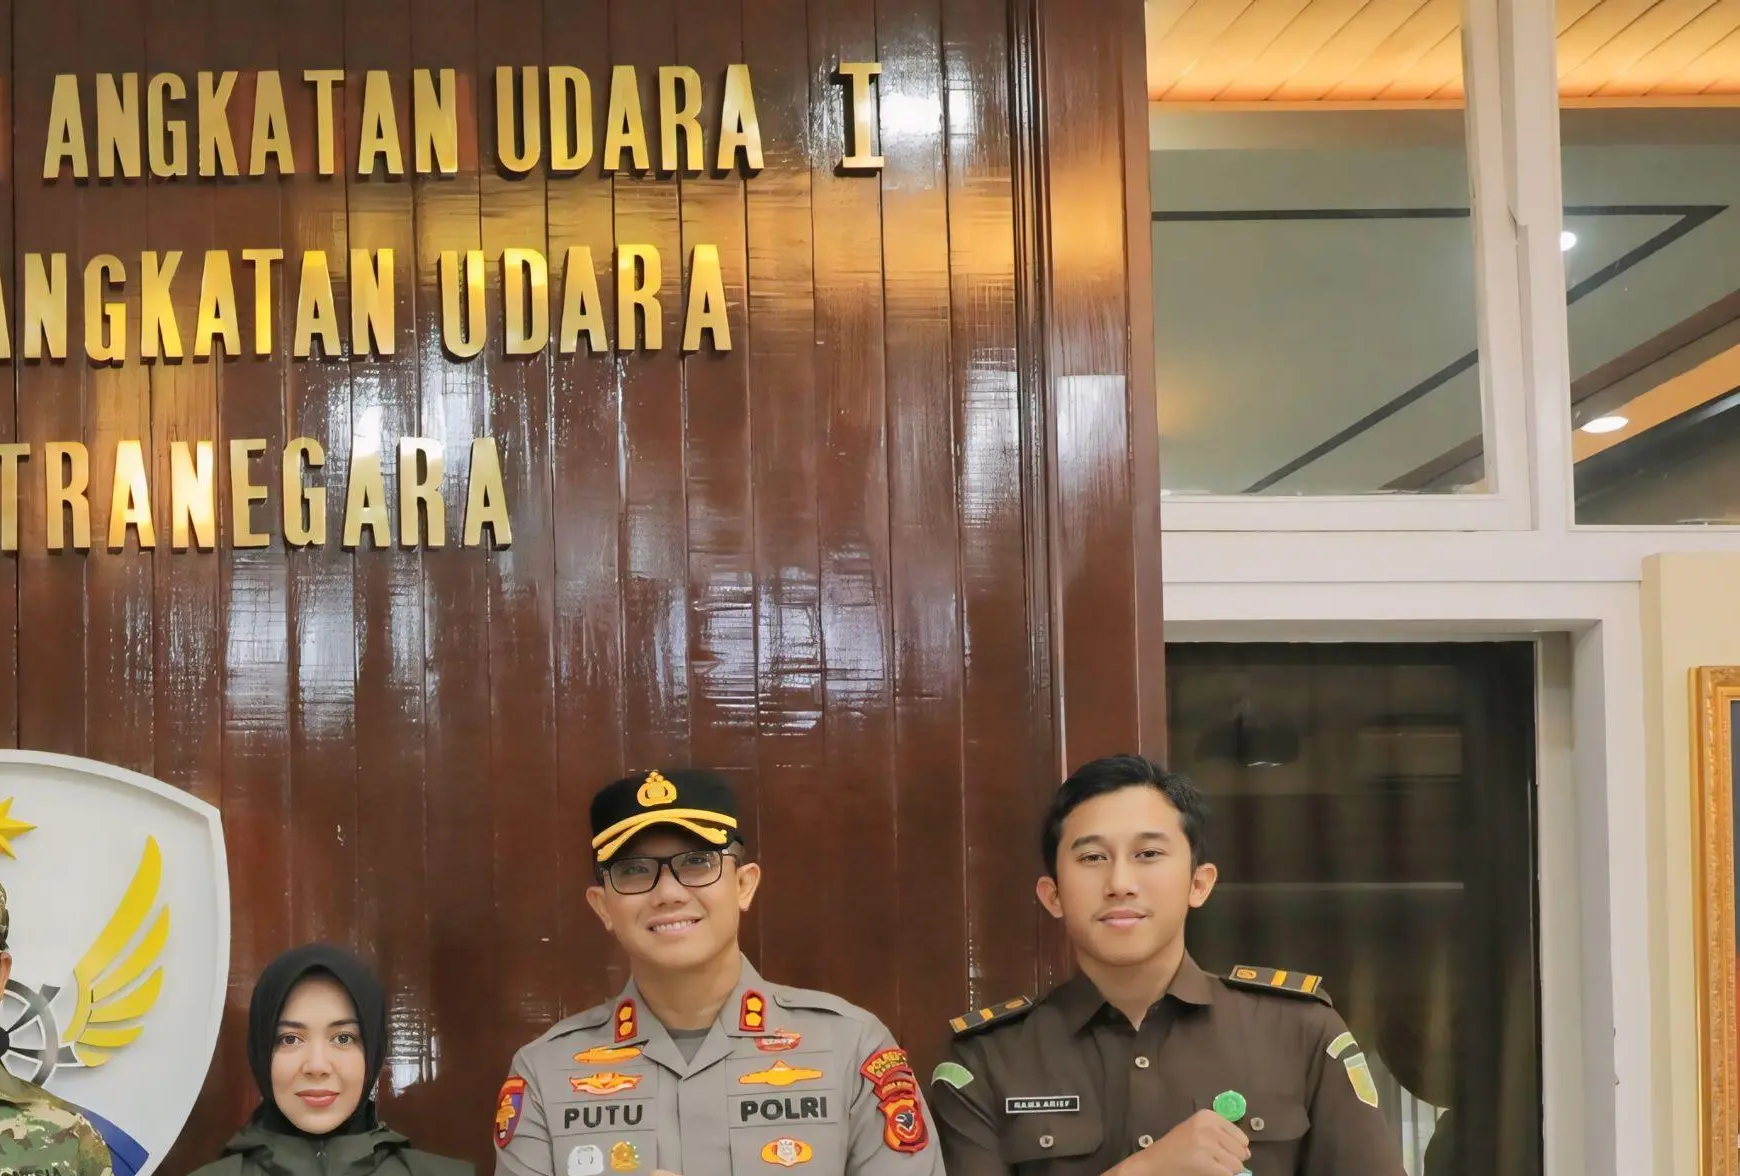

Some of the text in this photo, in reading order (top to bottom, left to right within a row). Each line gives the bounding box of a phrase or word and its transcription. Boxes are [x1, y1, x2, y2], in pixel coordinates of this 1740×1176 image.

[44, 69, 458, 178] ANGKATAN
[495, 63, 765, 171] UDARA
[838, 61, 885, 169] I
[441, 244, 733, 357] UDARA
[564, 1105, 643, 1129] PUTU
[740, 1097, 827, 1122] POLRI
